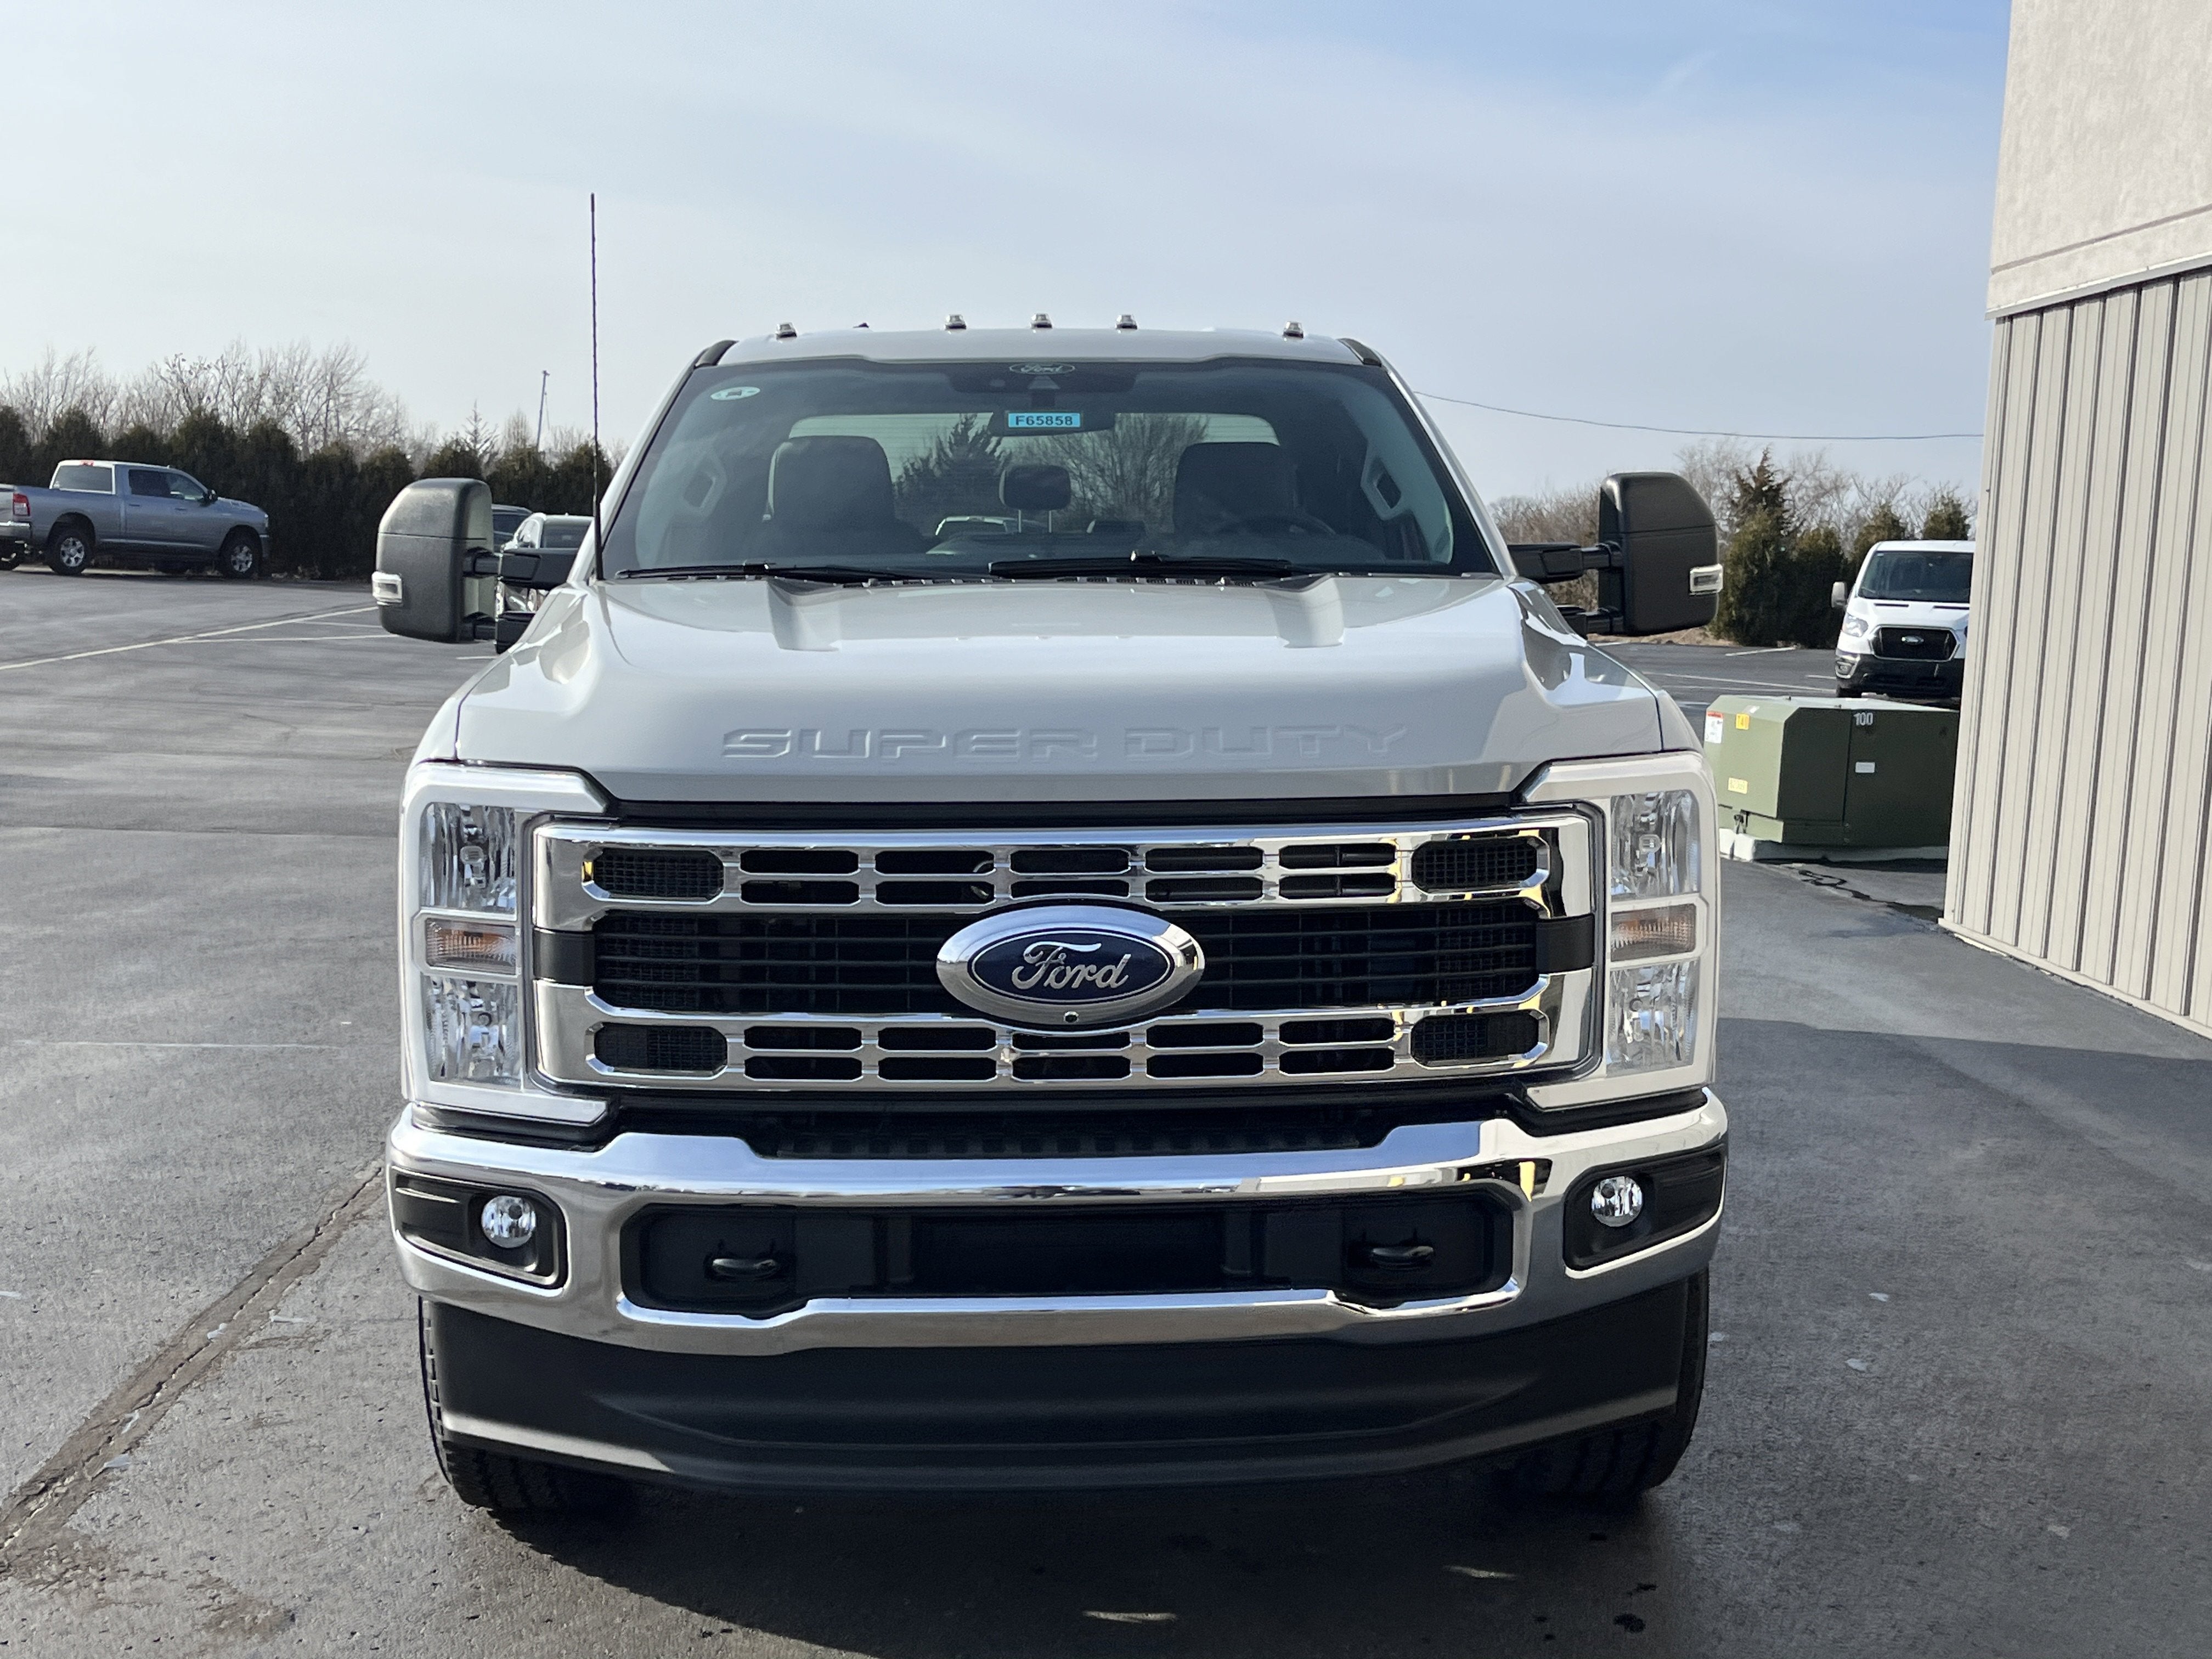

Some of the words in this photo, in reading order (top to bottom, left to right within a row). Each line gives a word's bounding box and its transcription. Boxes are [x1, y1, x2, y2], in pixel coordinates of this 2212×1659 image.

[1853, 712, 1874, 726] 100
[721, 729, 1097, 762] SUPER
[1124, 725, 1408, 760] DUTY
[1012, 941, 1131, 989] Ford
